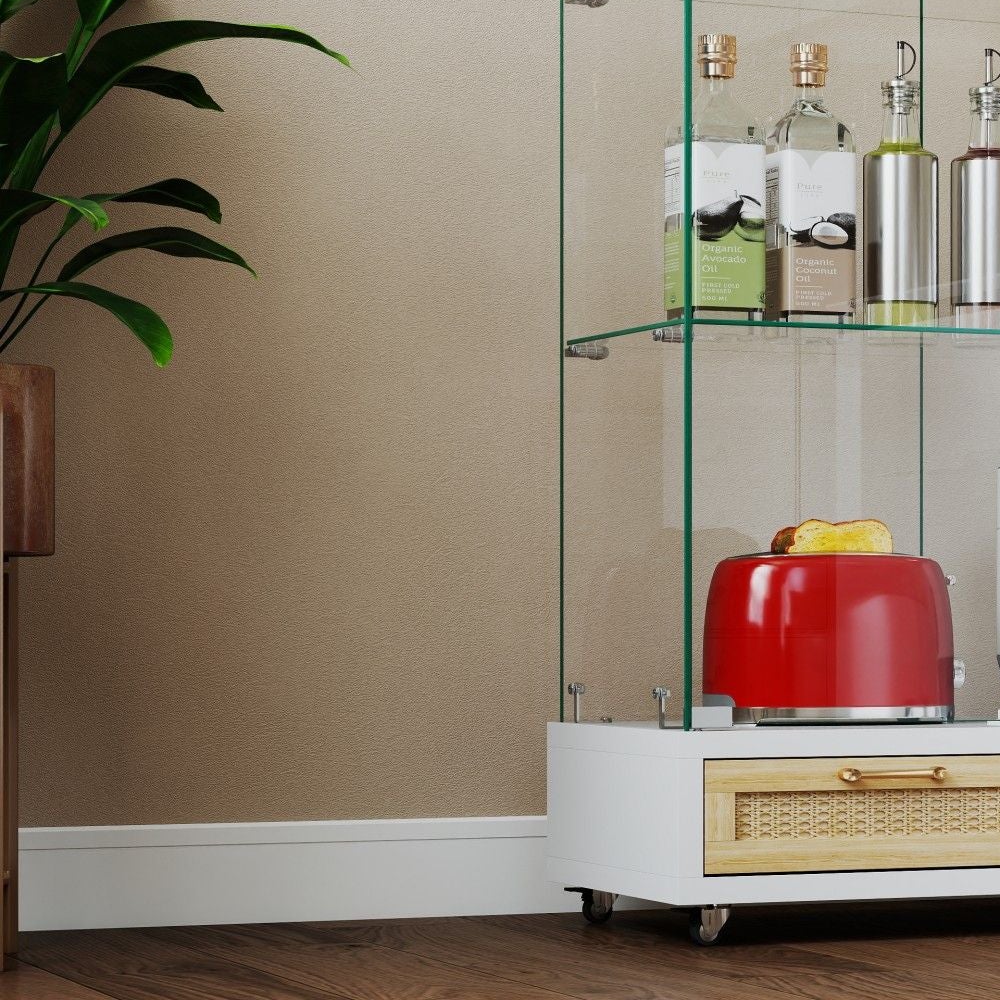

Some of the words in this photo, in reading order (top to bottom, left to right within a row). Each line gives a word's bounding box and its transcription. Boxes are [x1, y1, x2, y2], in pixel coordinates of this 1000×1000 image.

[702, 244, 743, 253] Organic
[702, 255, 747, 263] Avocado
[795, 257, 835, 267] Organic
[702, 265, 718, 273] Oil
[795, 267, 838, 275] Coconut
[795, 275, 811, 283] Oil
